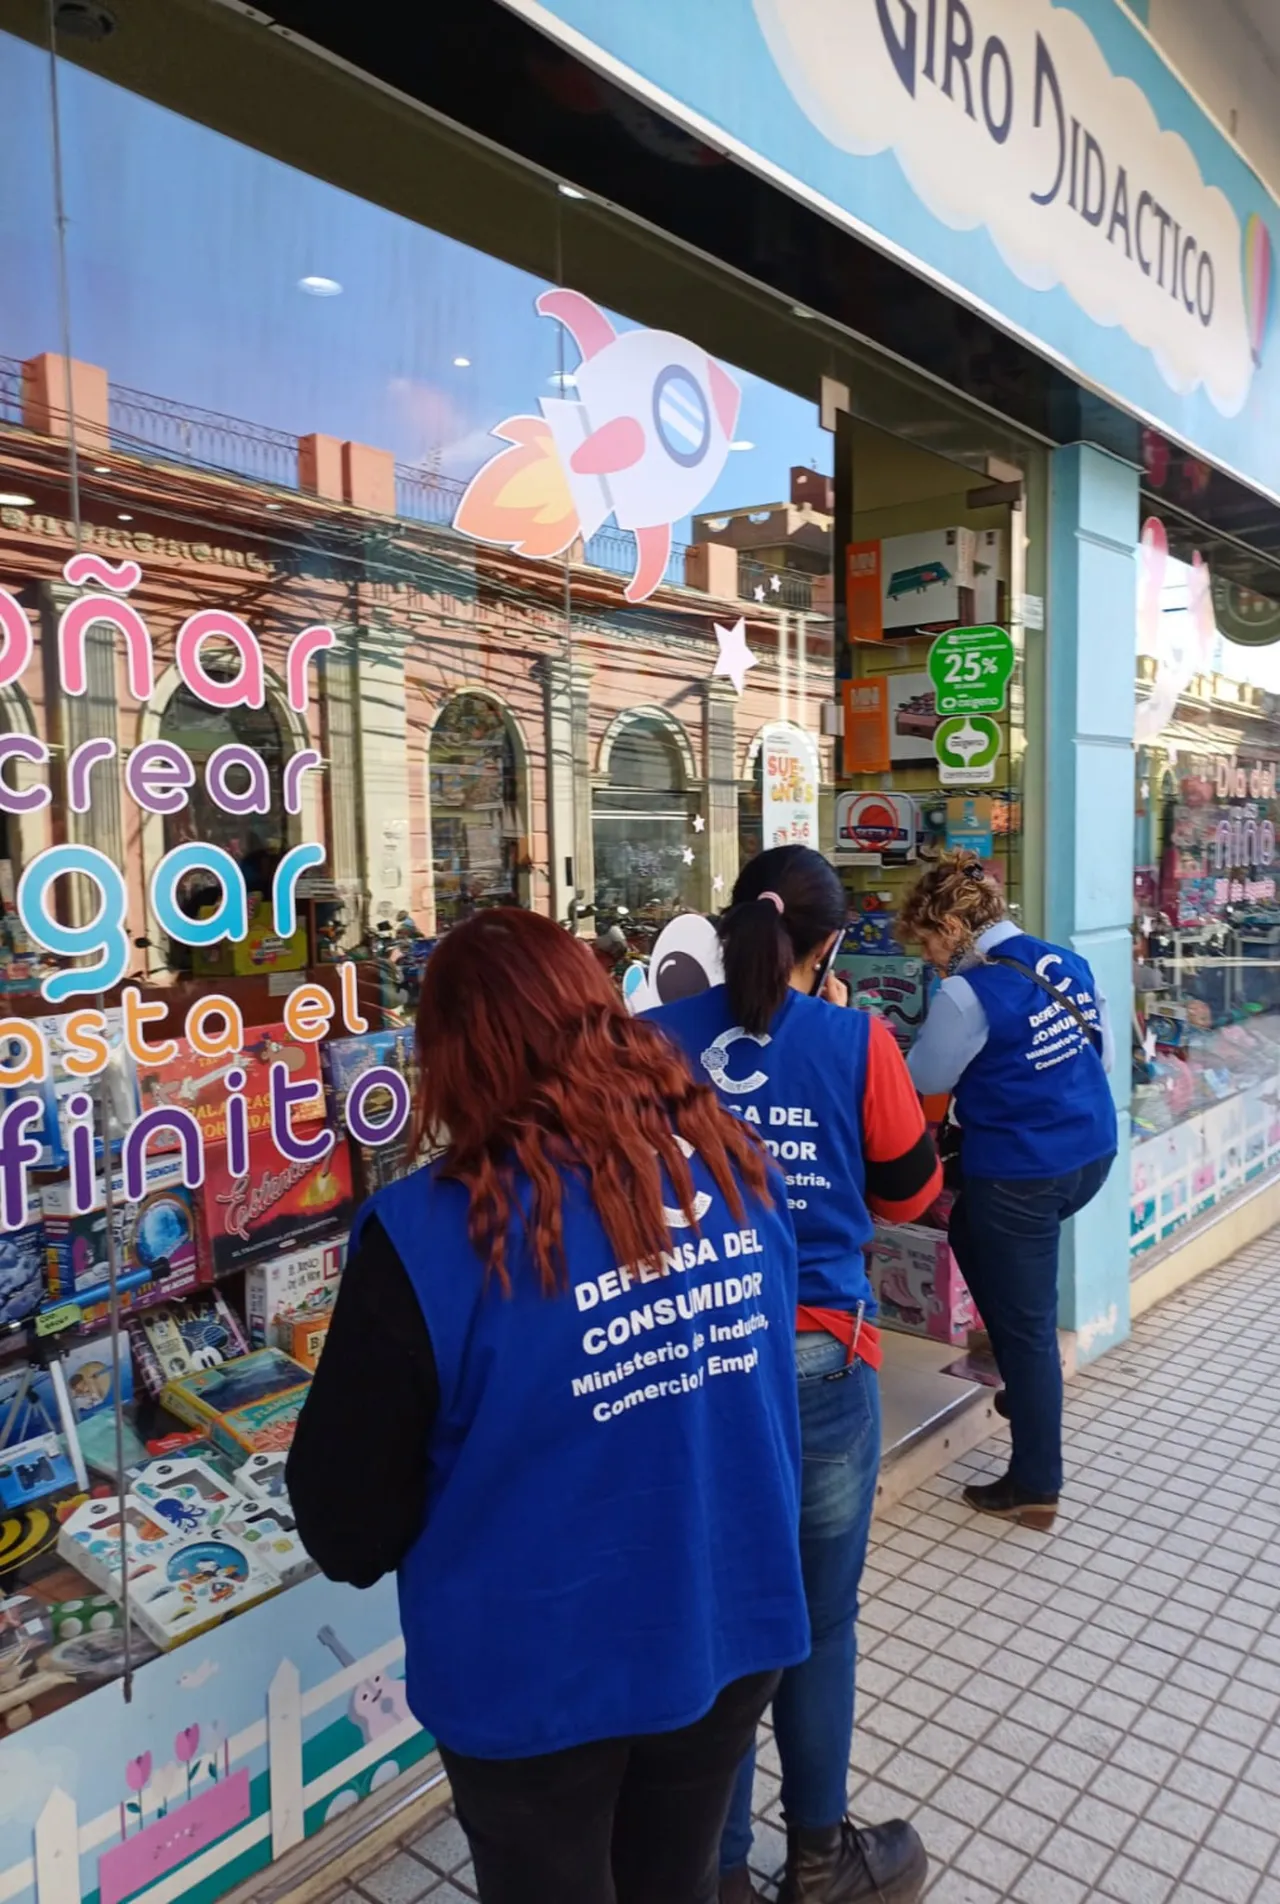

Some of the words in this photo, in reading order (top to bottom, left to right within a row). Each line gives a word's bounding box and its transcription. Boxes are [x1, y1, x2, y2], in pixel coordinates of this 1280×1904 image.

[1030, 30, 1215, 327] DIDACTICO
[943, 651, 999, 684] 25%
[284, 961, 369, 1042] el
[768, 1105, 819, 1128] DEL
[0, 1060, 411, 1231] finito
[722, 1228, 764, 1259] DEL
[570, 1341, 690, 1398] Ministerio
[592, 1372, 699, 1423] Comercio
